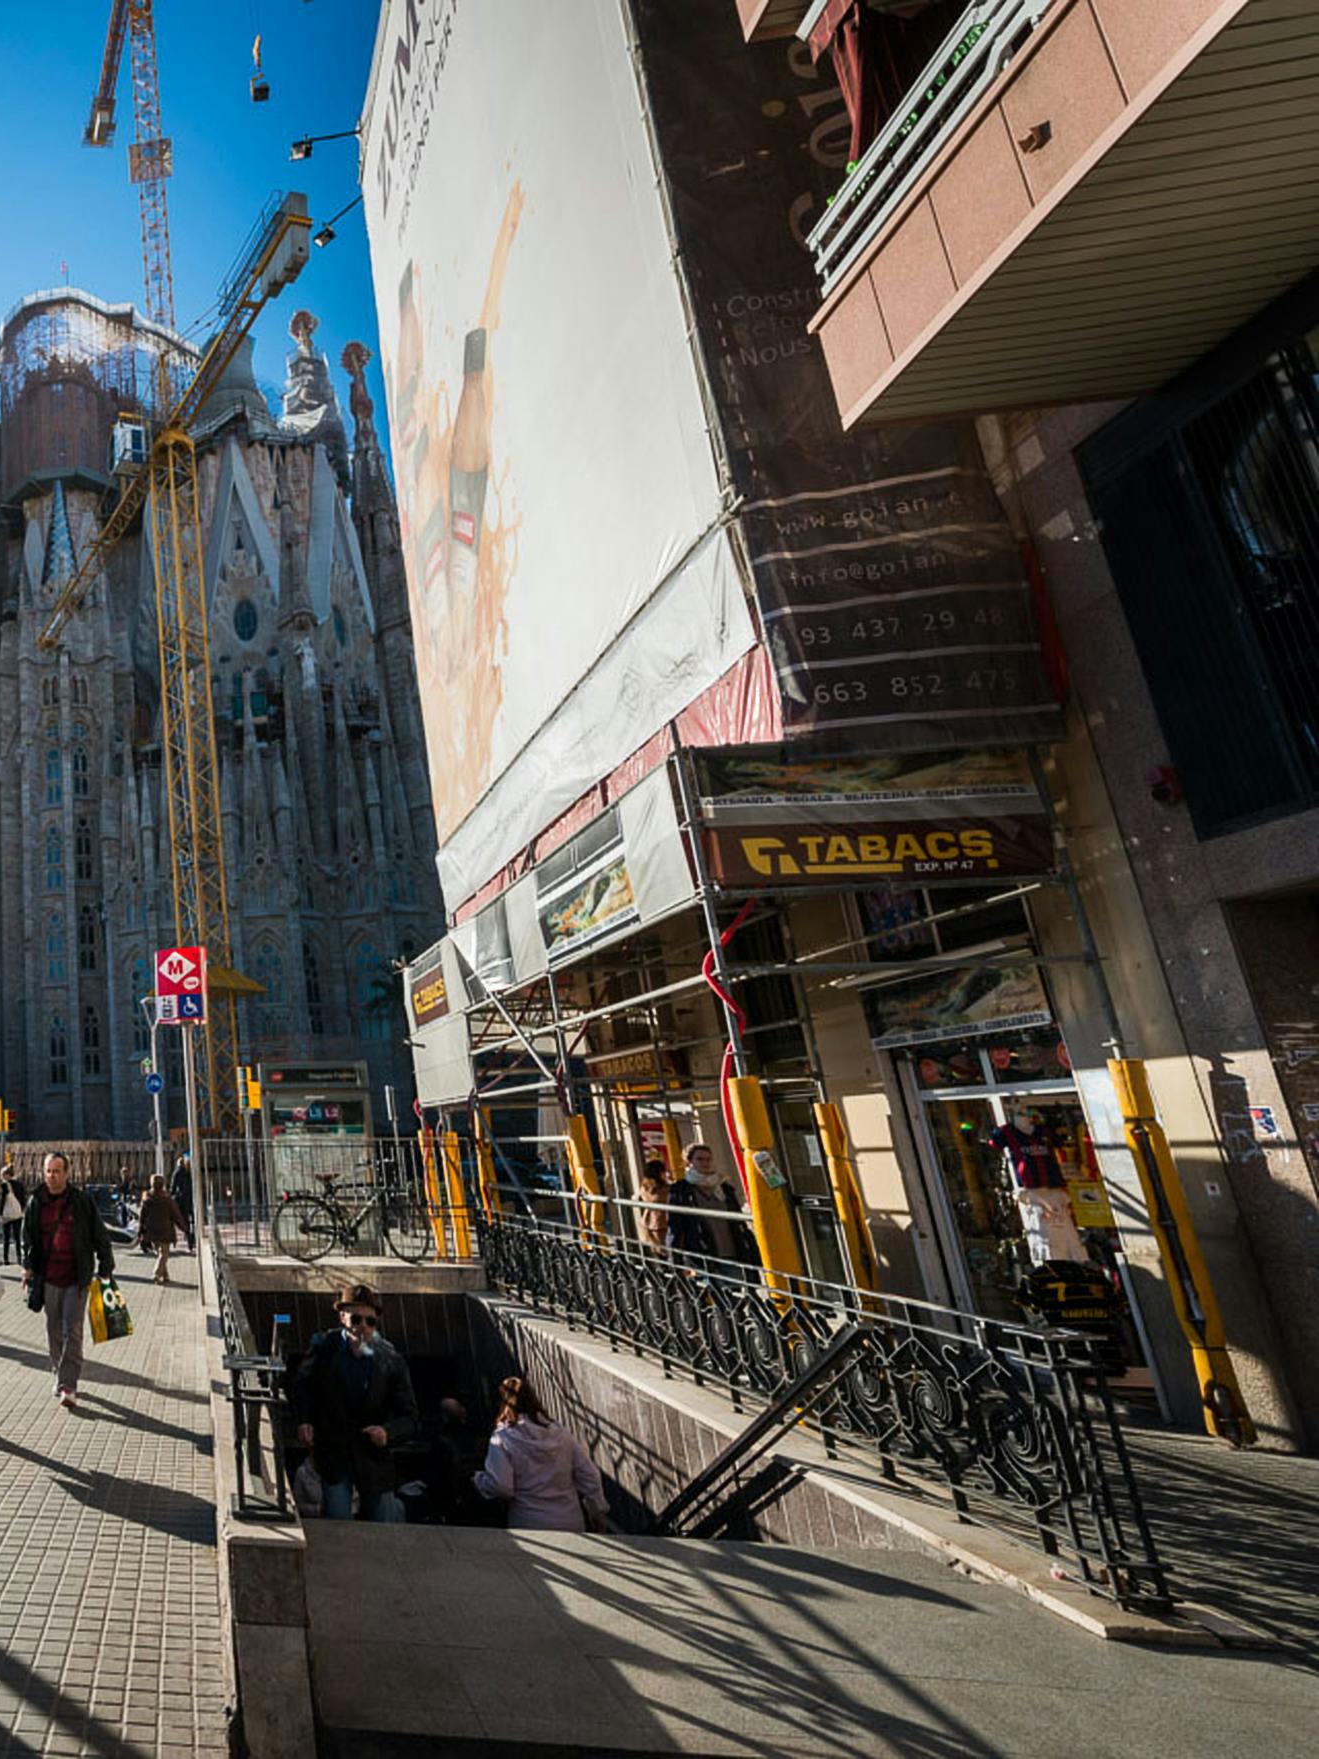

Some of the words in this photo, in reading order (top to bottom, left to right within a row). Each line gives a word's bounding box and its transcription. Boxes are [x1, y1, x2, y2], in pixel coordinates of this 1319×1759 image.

[378, 0, 422, 220] ZUM
[800, 625, 833, 646] 93
[851, 617, 901, 641] 437
[922, 610, 956, 633] 29
[813, 680, 868, 705] 663
[890, 674, 943, 697] 852
[797, 829, 995, 863] TABACS
[167, 959, 184, 976] M
